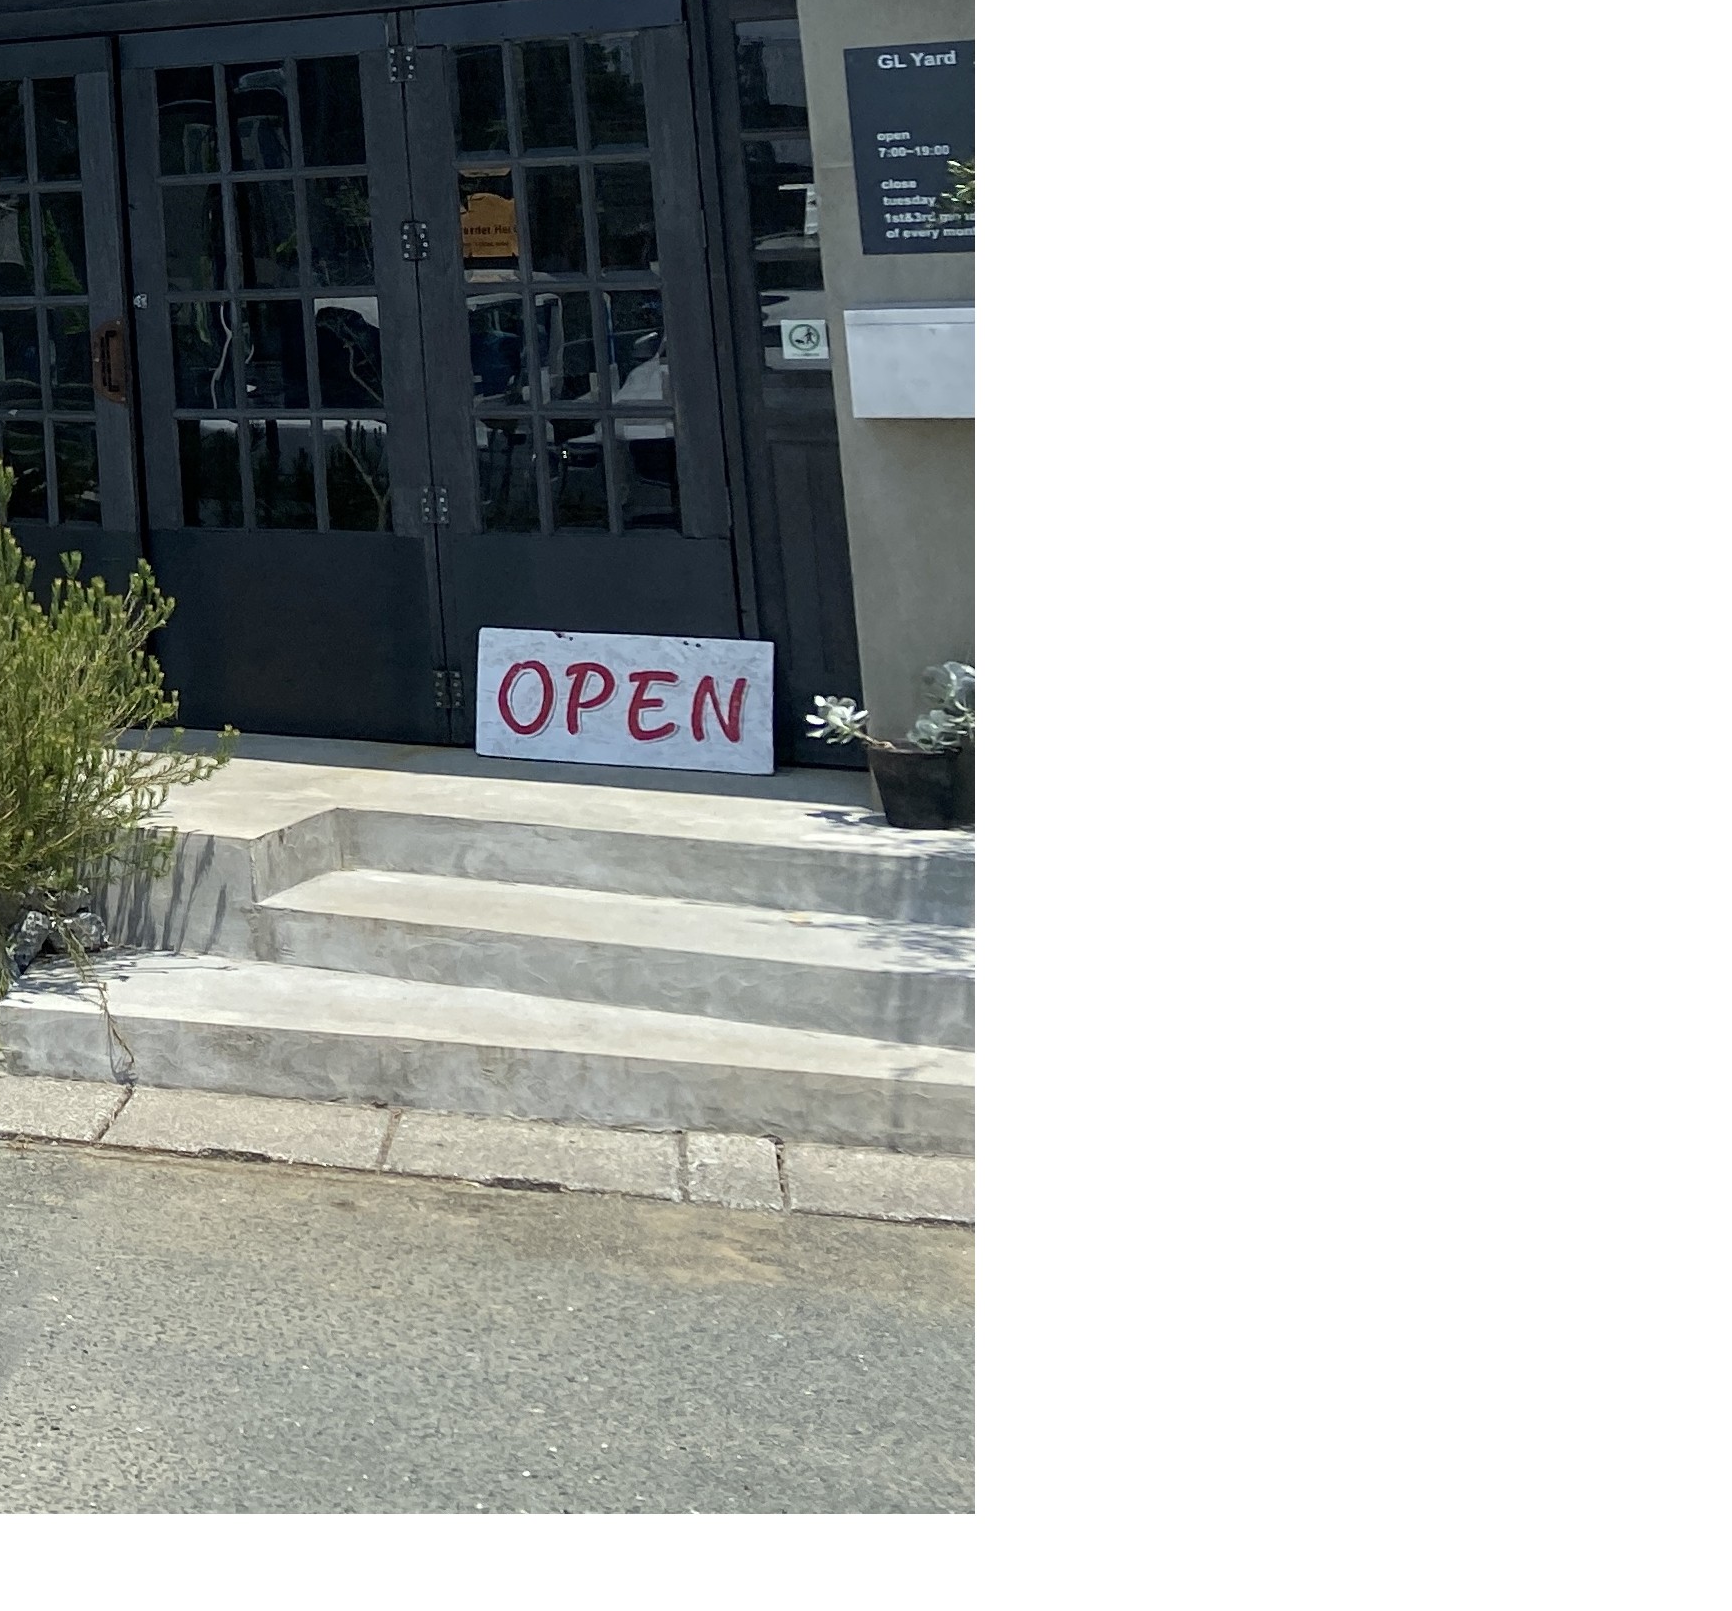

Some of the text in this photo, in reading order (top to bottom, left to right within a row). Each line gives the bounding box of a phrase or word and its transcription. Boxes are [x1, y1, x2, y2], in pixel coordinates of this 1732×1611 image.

[878, 50, 957, 68] GL Yard
[877, 132, 910, 142] open
[881, 179, 917, 189] close
[883, 195, 936, 207] tuesday
[886, 228, 899, 238] of
[903, 229, 939, 239] every
[498, 660, 748, 743] OPEN
